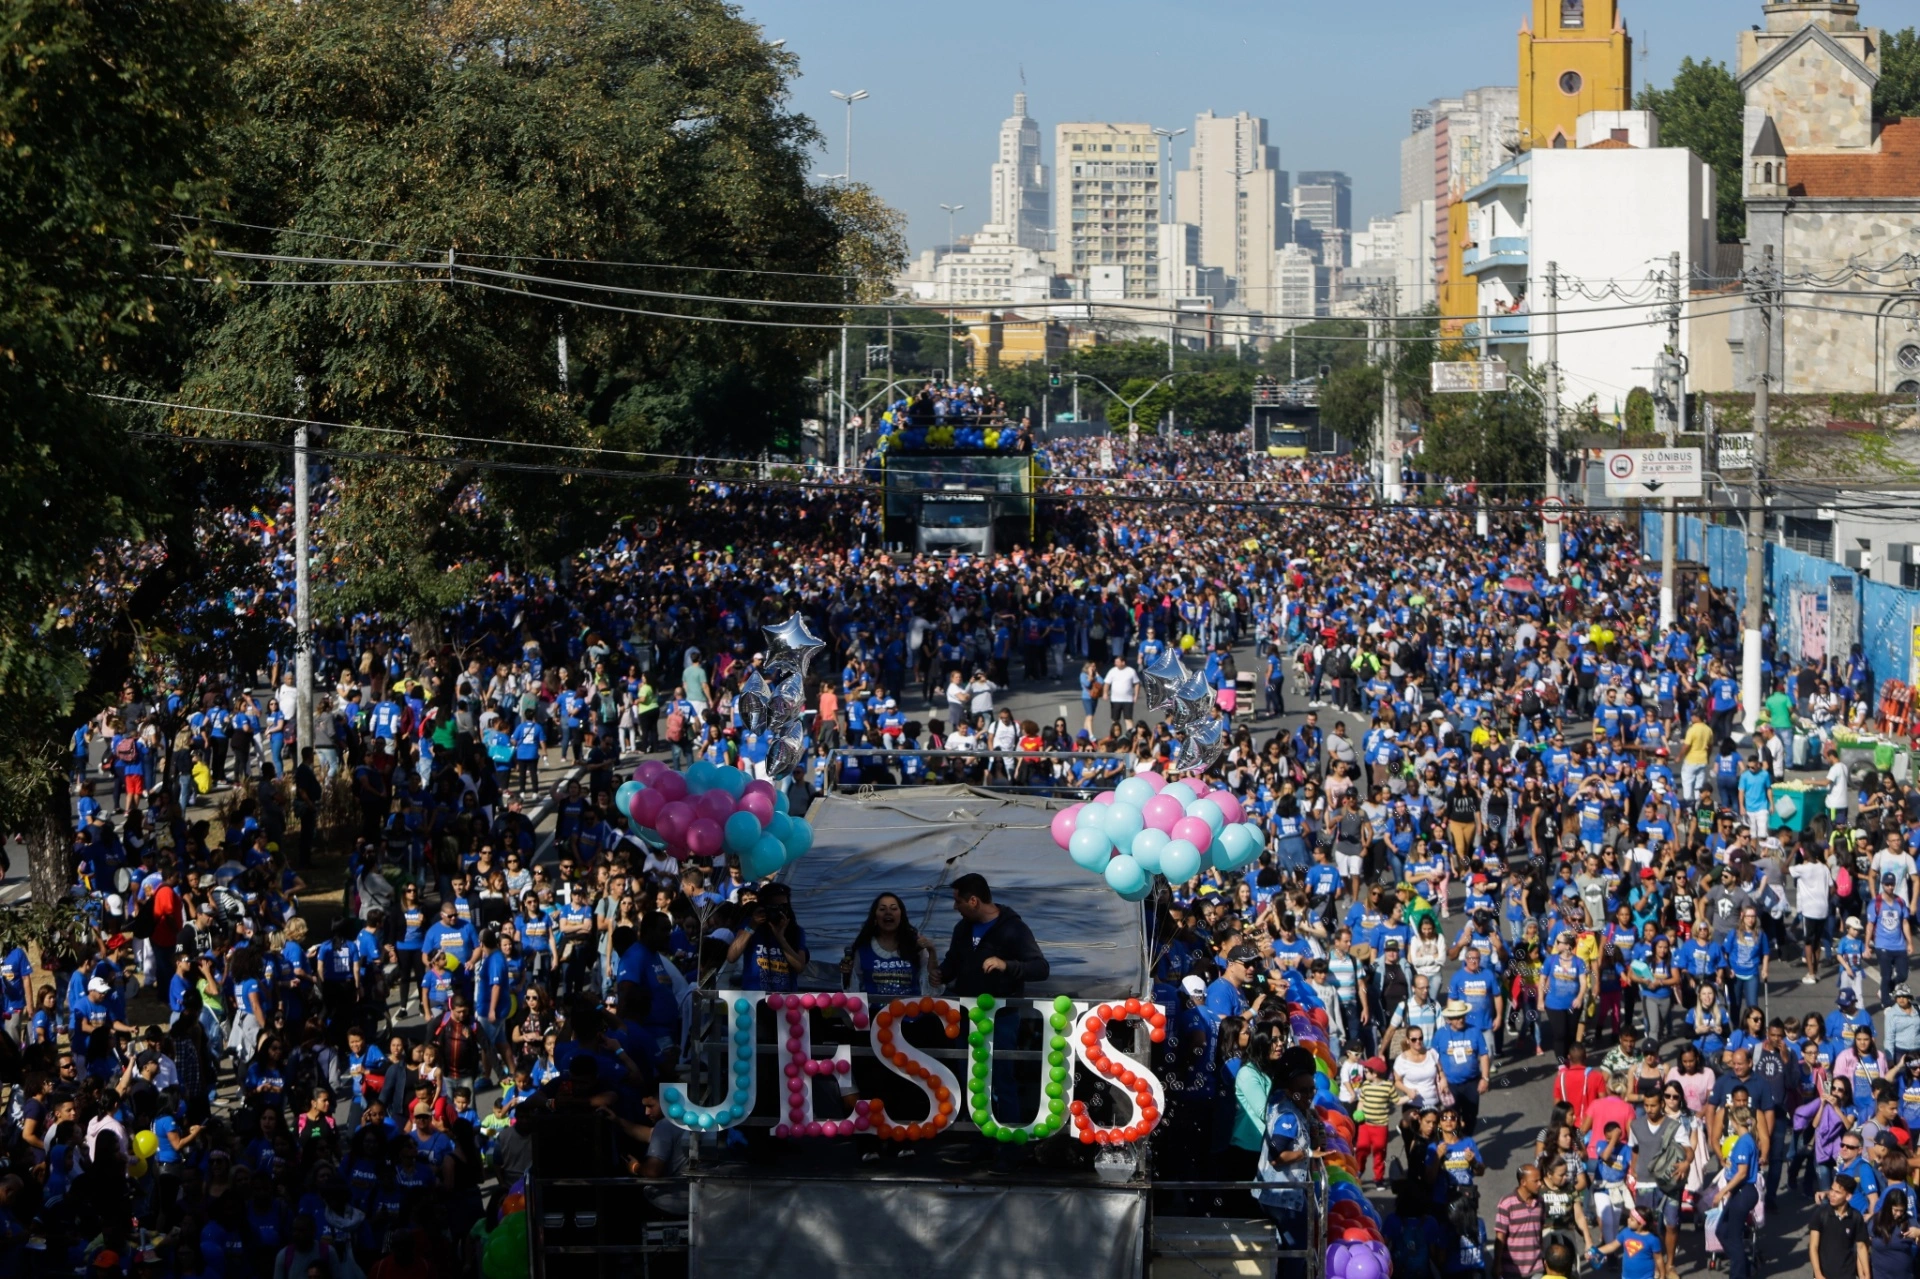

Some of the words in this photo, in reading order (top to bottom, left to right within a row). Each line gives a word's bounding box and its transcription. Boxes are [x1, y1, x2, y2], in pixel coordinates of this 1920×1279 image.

[1642, 451, 1654, 461] SÓ
[1658, 451, 1693, 461] ÔNIBUS
[872, 959, 912, 970] Jesus
[659, 989, 1167, 1145] JESUS
[1765, 1062, 1775, 1076] 99
